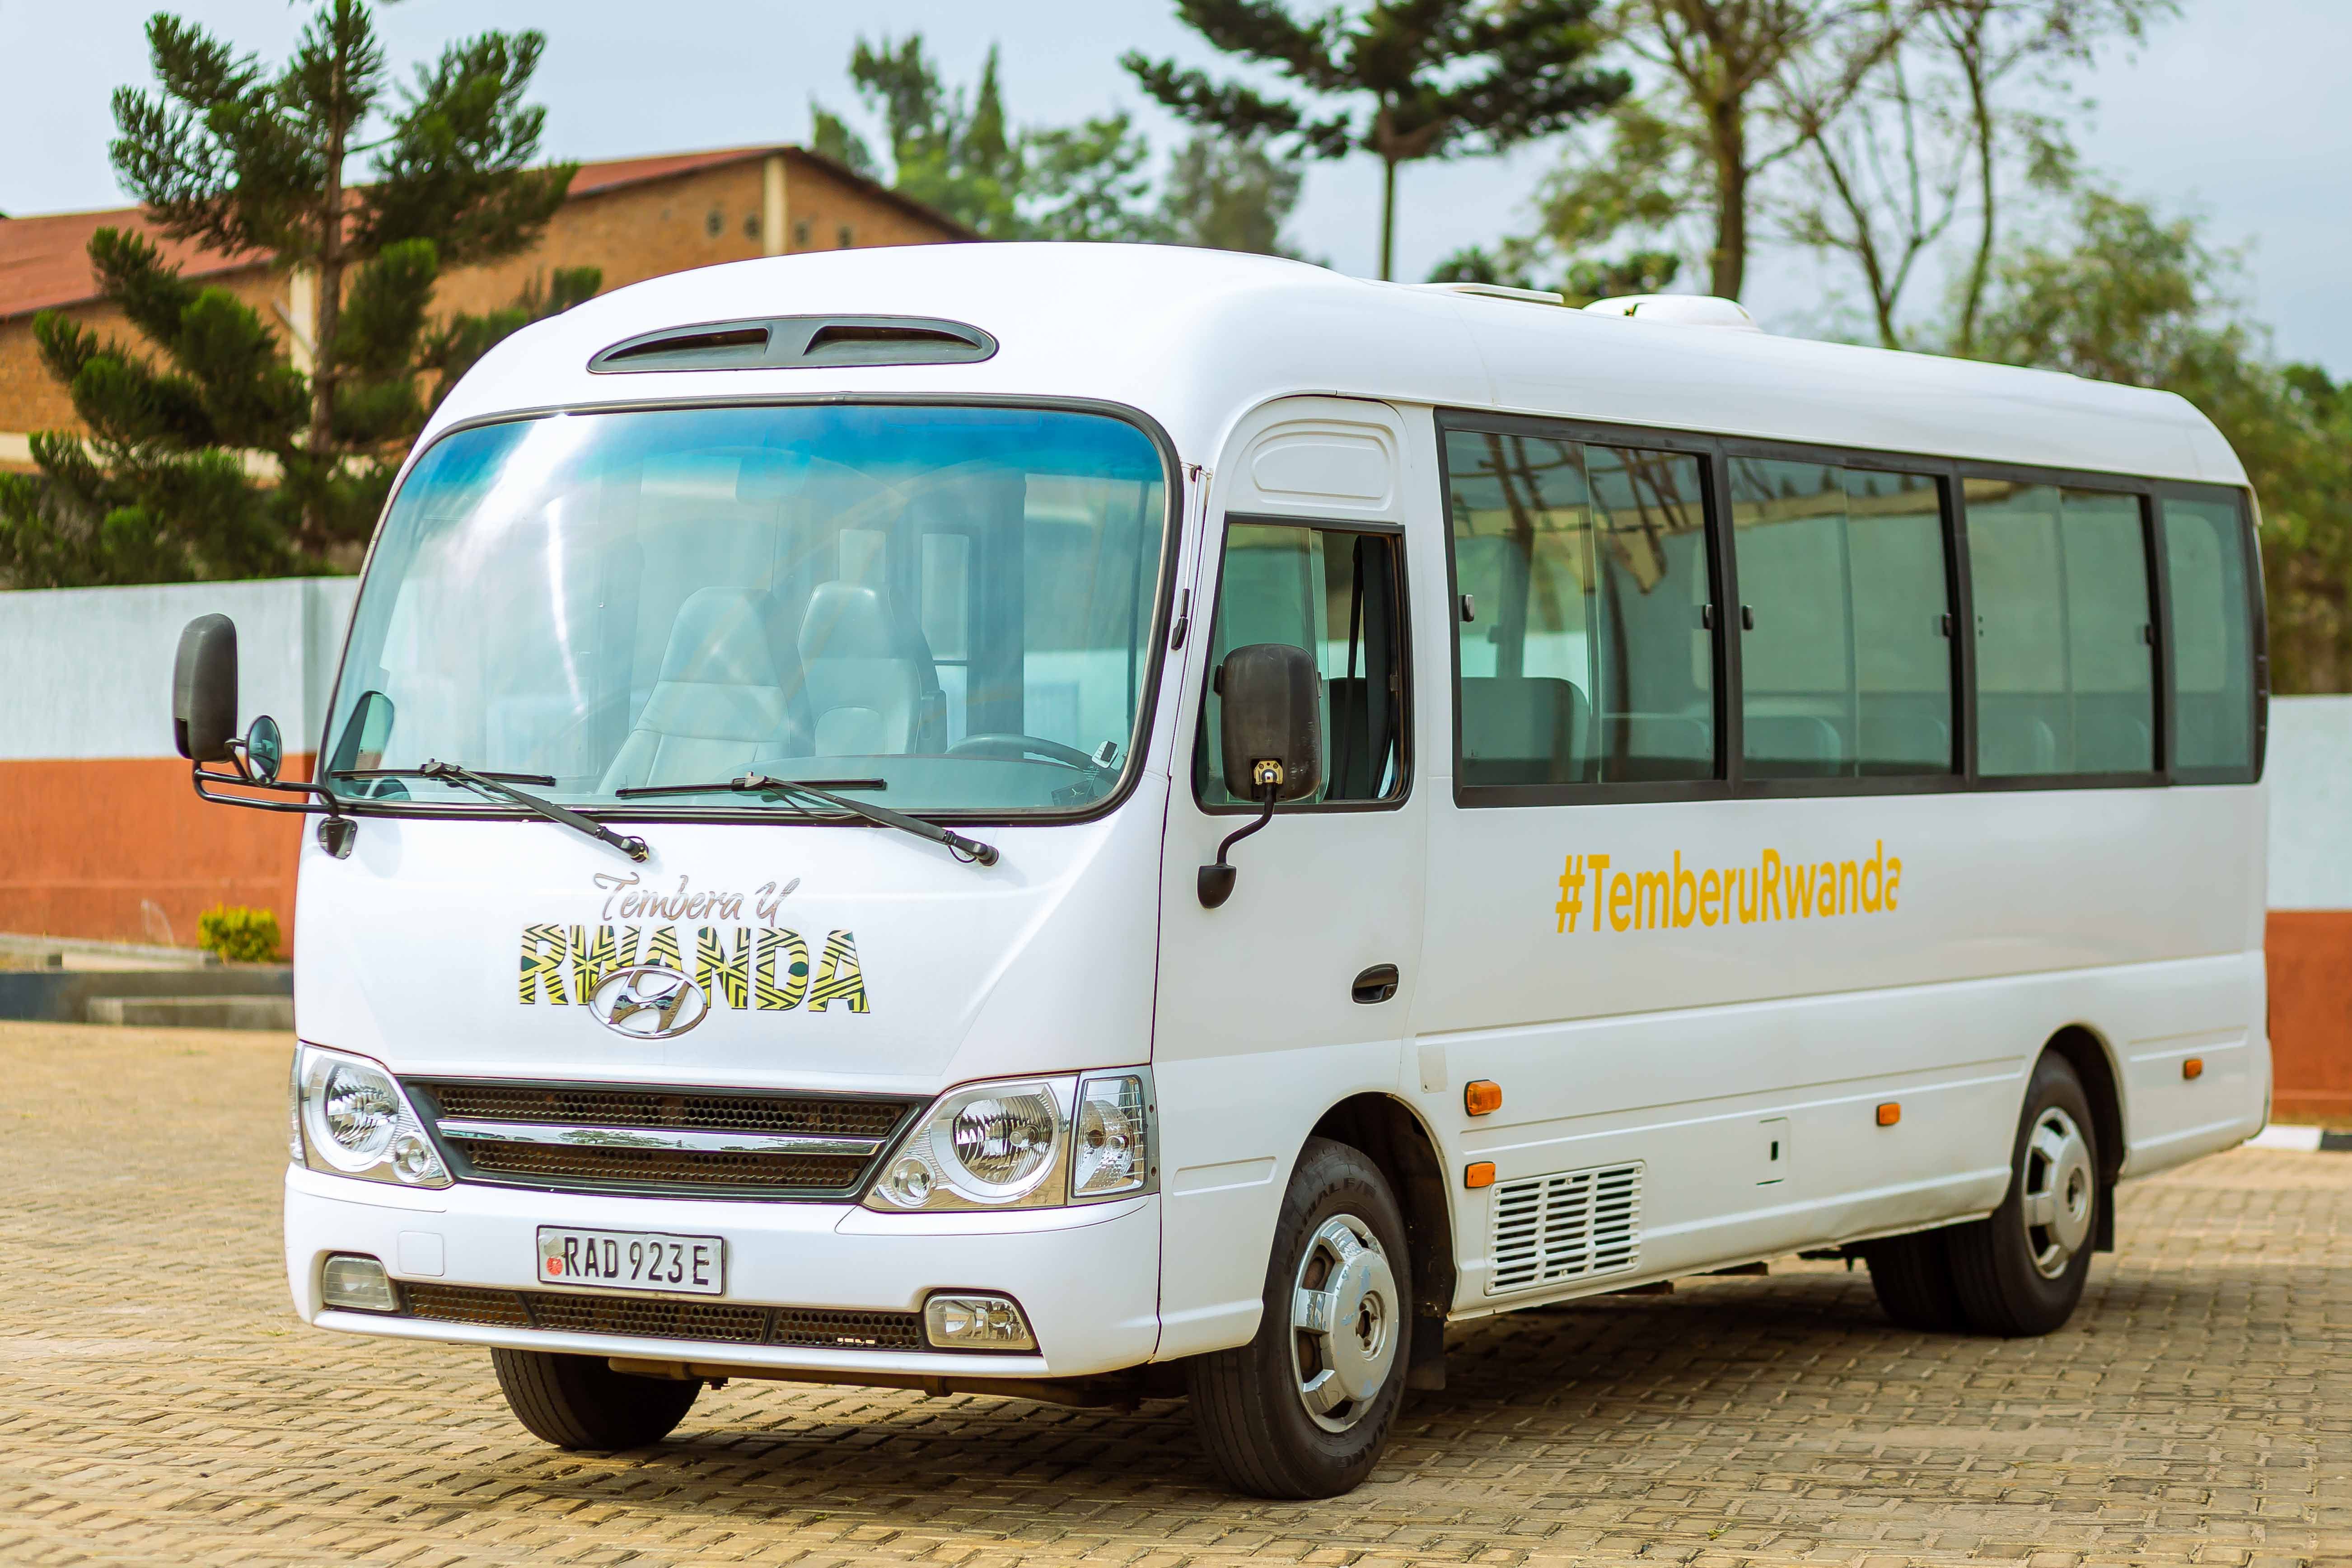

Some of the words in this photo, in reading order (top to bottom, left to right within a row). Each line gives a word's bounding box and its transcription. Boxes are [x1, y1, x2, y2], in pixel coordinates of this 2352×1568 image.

[593, 871, 744, 922] Tembera
[1555, 838, 1903, 934] #TemberuRwanda
[563, 1236, 619, 1278] RAD
[629, 1240, 683, 1284] 923
[692, 1245, 710, 1286] E
